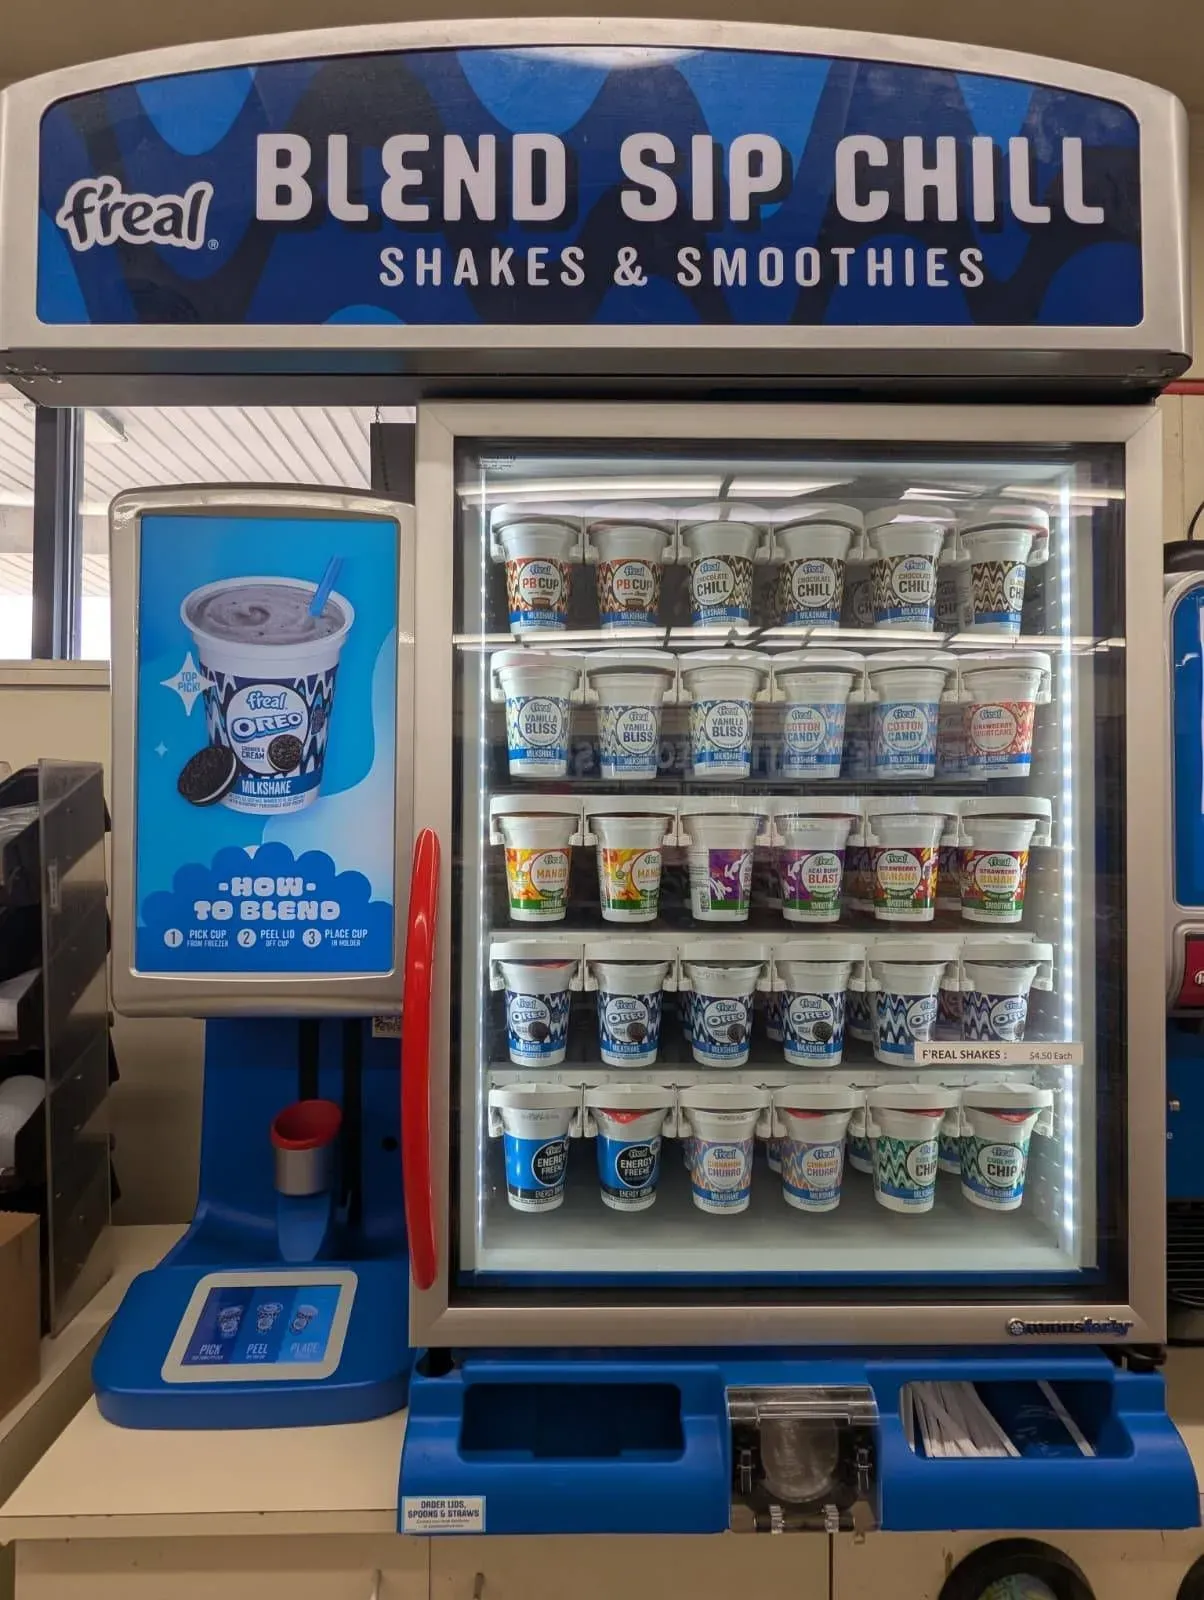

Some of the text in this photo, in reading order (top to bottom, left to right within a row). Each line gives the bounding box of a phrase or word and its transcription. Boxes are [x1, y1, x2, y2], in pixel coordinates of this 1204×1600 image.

[256, 133, 1104, 223] BLEND SIP CHILL
[379, 246, 984, 287] SHAKES & SMOOTHIES
[522, 577, 559, 590] PB CUP
[616, 578, 652, 590] PB CUP
[696, 580, 729, 597] CHILL
[898, 580, 931, 593] CHILL
[797, 583, 831, 597] CHILL
[180, 672, 197, 681] TOP
[525, 714, 558, 723] VANILLA
[231, 712, 303, 743] OREO
[525, 723, 557, 734] BLISS
[623, 723, 653, 731] VANILLA
[712, 726, 743, 737] BLISS
[623, 732, 653, 742] BLISS
[787, 732, 819, 741] CANDY
[887, 732, 922, 741] CANDY
[241, 751, 265, 759] CREAM
[241, 780, 291, 794] MILKSHAKE
[193, 900, 341, 921] TO BLEND
[189, 929, 208, 939] PICK
[210, 929, 227, 939] CUP
[260, 929, 280, 939] PEEL
[282, 929, 295, 939] LID
[324, 928, 349, 939] PLACE
[351, 928, 368, 939] CUP
[511, 1011, 547, 1022] OREO
[608, 1011, 646, 1024] OREO
[707, 1012, 746, 1027] OREO
[792, 1010, 832, 1024] OREO
[922, 1050, 957, 1059] F'REAL
[960, 1050, 1000, 1059] SHAKES
[1054, 1052, 1073, 1060] Each
[620, 1156, 653, 1168] ENERGY
[200, 1344, 223, 1355] PICK
[246, 1343, 268, 1354] PEEL
[421, 1500, 446, 1509] ORDER
[408, 1509, 438, 1518] SPOONS
[447, 1509, 480, 1517] STRAWS
